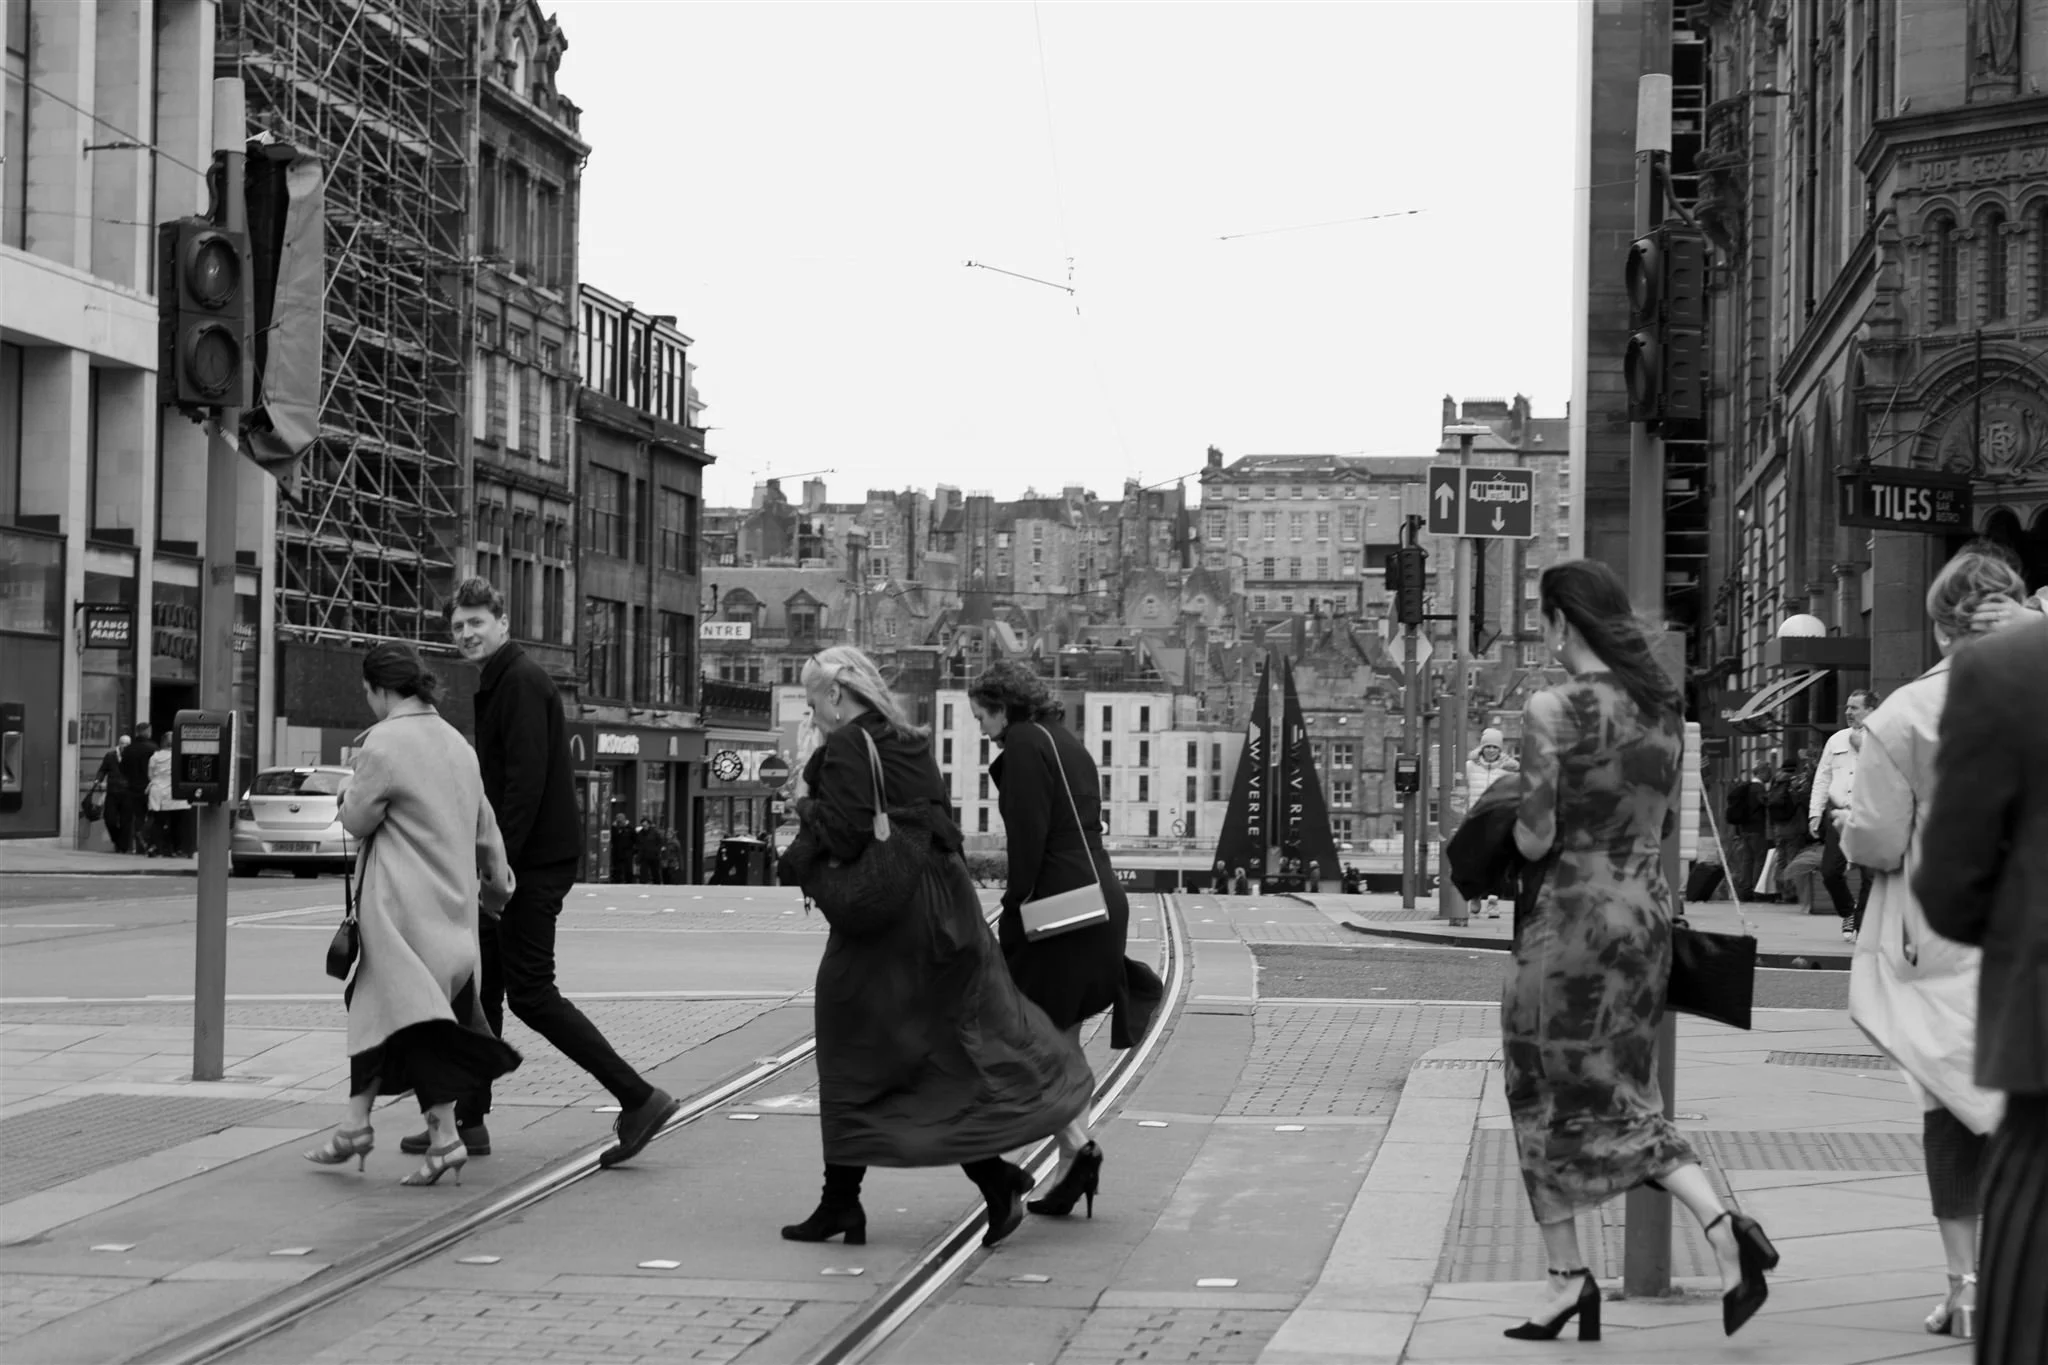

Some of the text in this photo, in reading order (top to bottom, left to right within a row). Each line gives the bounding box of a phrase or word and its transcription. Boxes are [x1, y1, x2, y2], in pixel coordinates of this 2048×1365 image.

[1871, 484, 1933, 521] TILES
[90, 629, 129, 641] MANCA
[703, 625, 743, 636] NTRE
